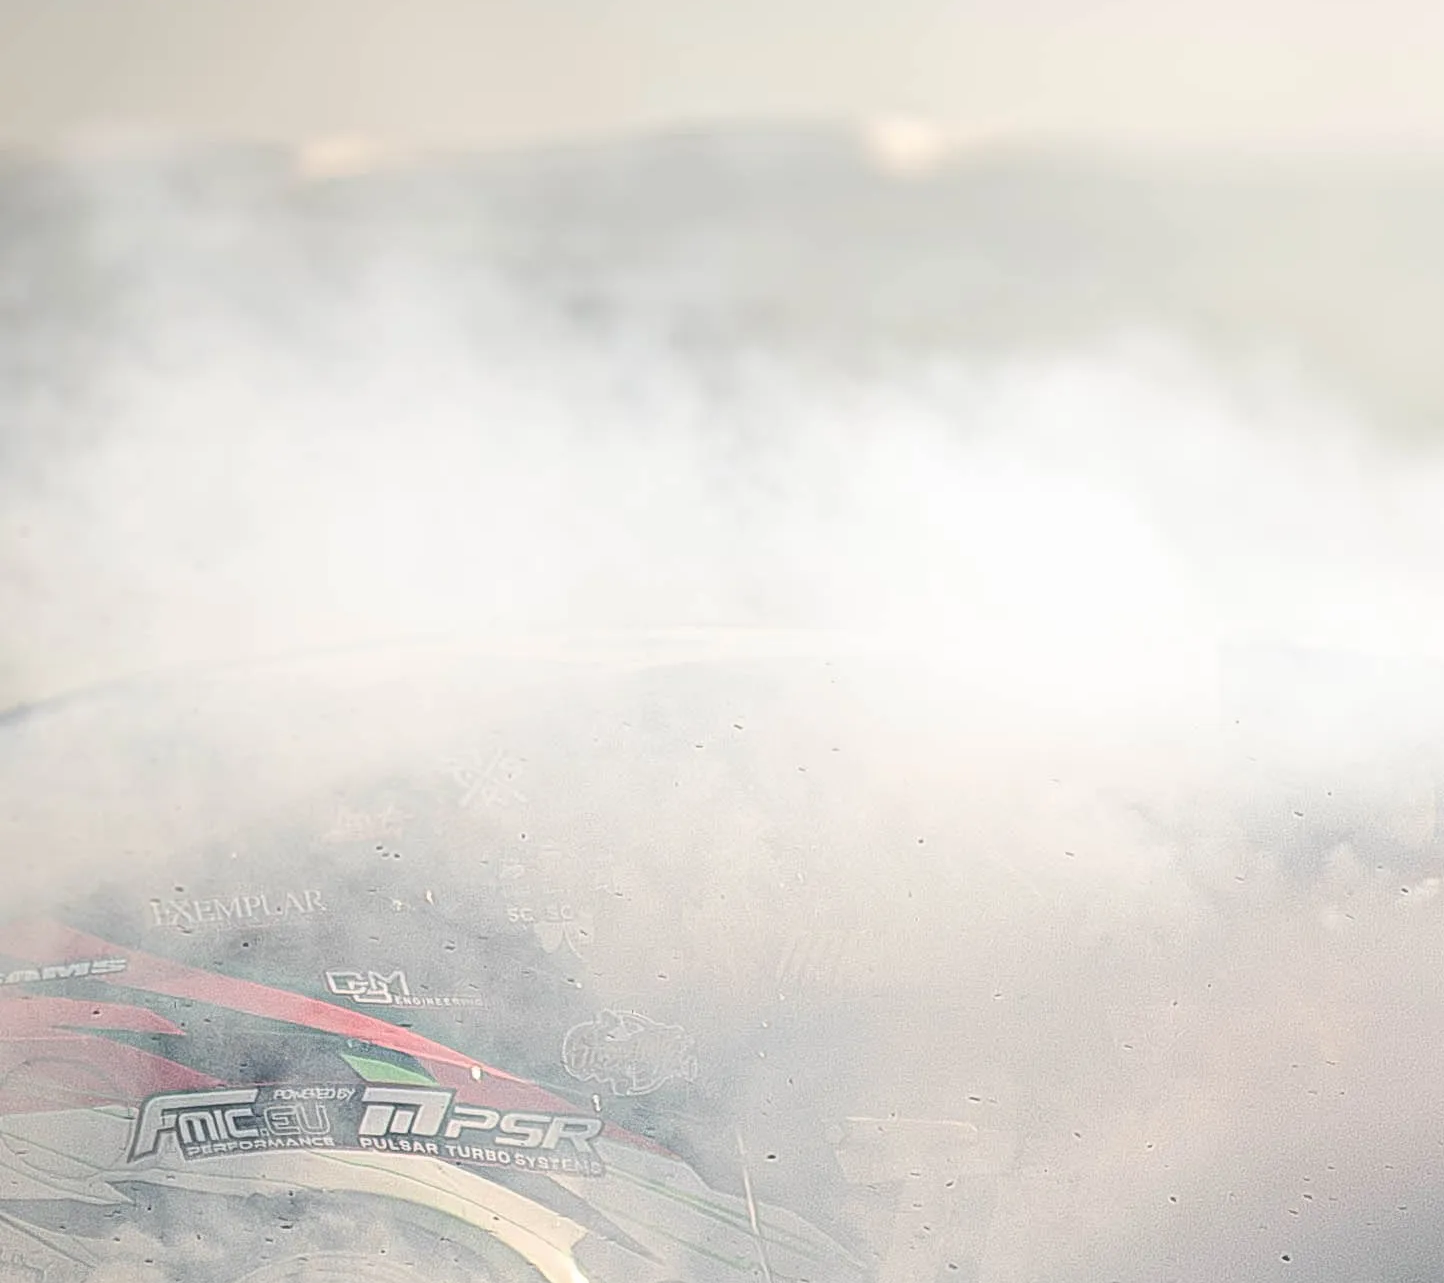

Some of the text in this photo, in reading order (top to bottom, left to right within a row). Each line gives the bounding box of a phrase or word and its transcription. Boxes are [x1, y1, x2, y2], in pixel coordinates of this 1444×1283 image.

[0, 958, 127, 985] AMS
[186, 1136, 335, 1158] PERFORMANCE
[360, 1137, 439, 1156] PULSAR
[446, 1144, 511, 1164] TURBO
